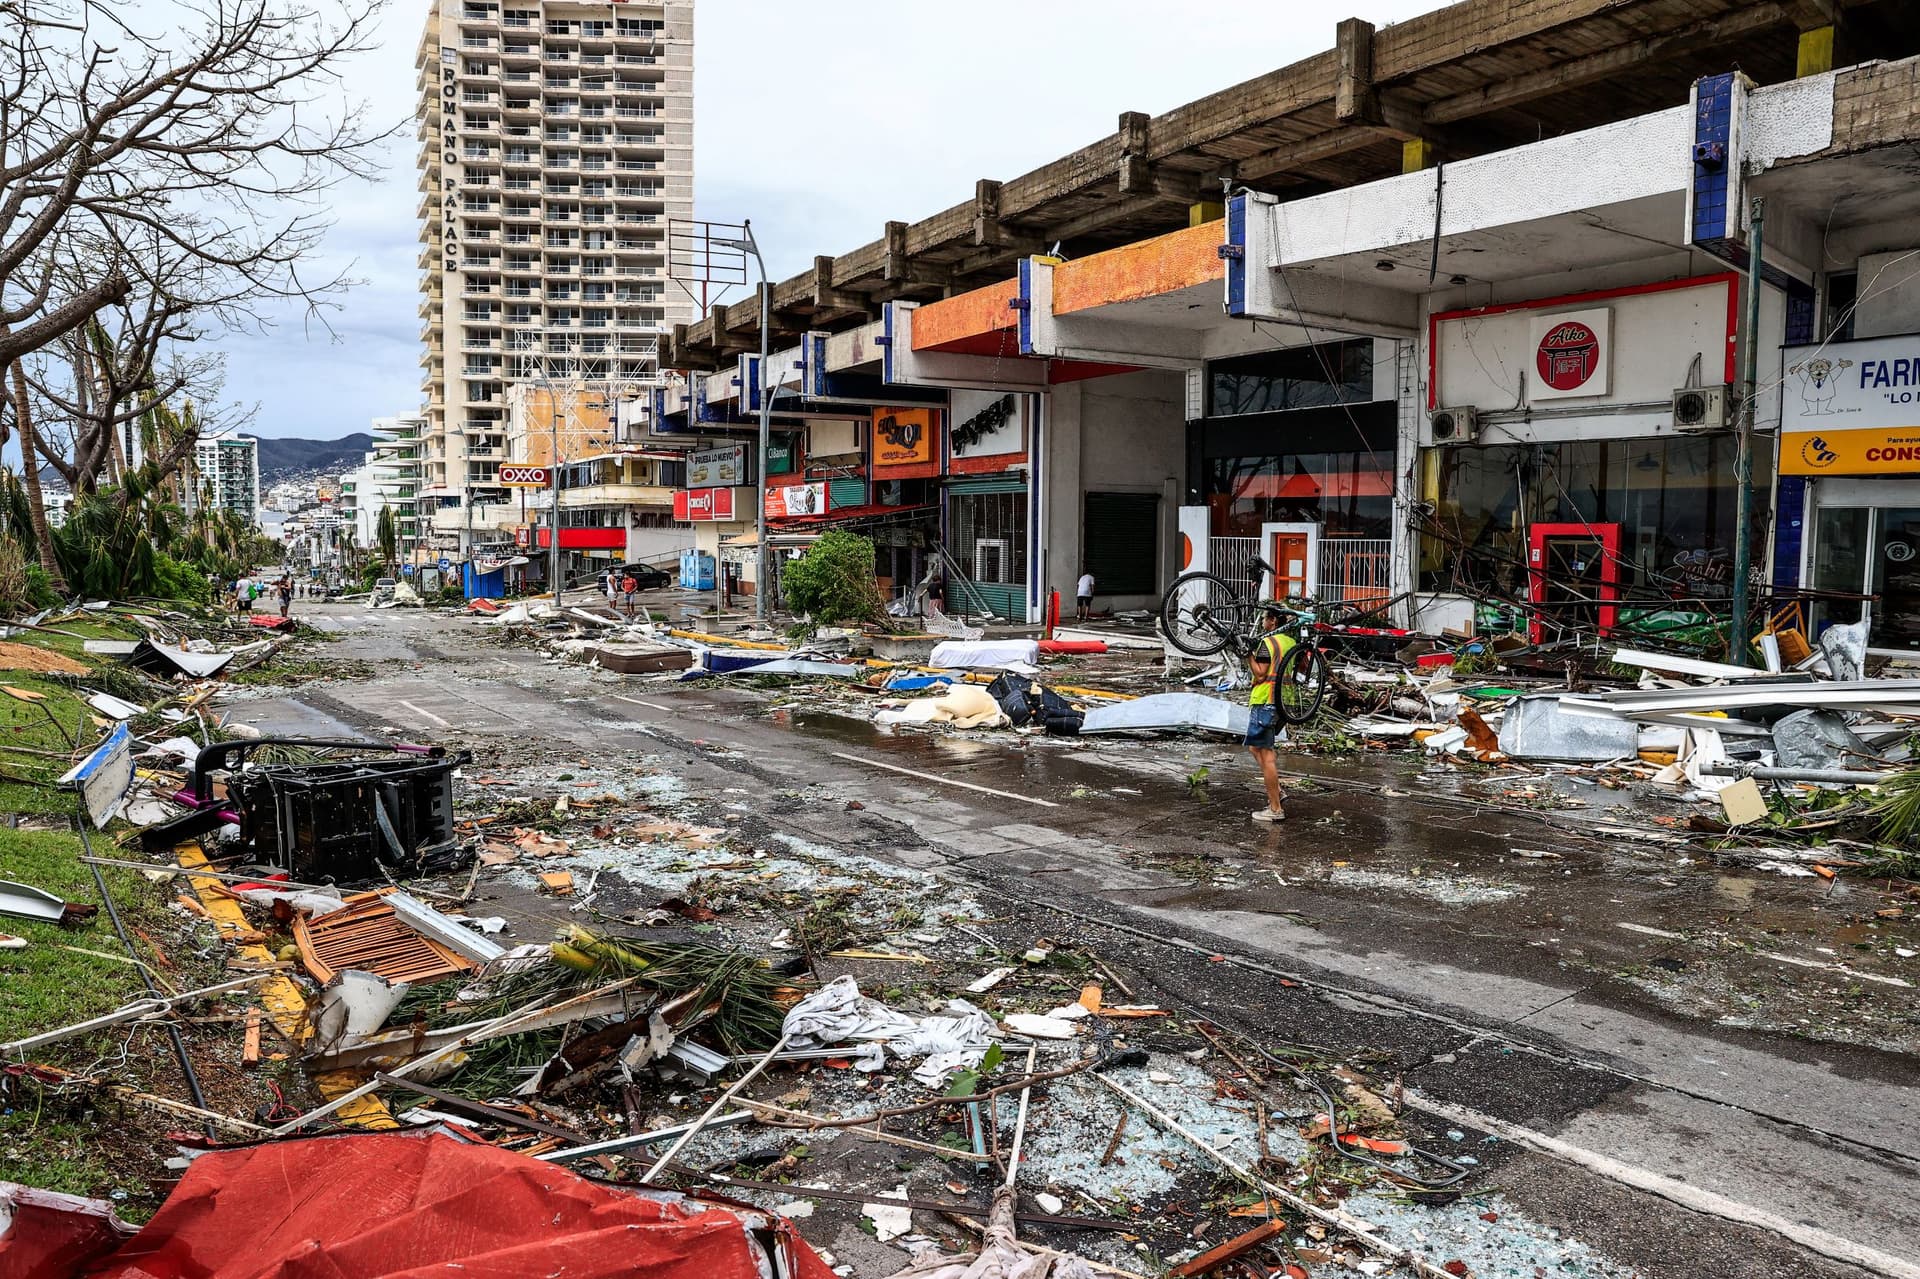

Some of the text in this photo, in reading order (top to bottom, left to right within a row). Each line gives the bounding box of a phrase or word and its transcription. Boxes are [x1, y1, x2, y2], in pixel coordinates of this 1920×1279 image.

[443, 68, 457, 273] ROMANO PALACE
[1548, 327, 1589, 346] Aiko
[502, 468, 545, 482] OXXO
